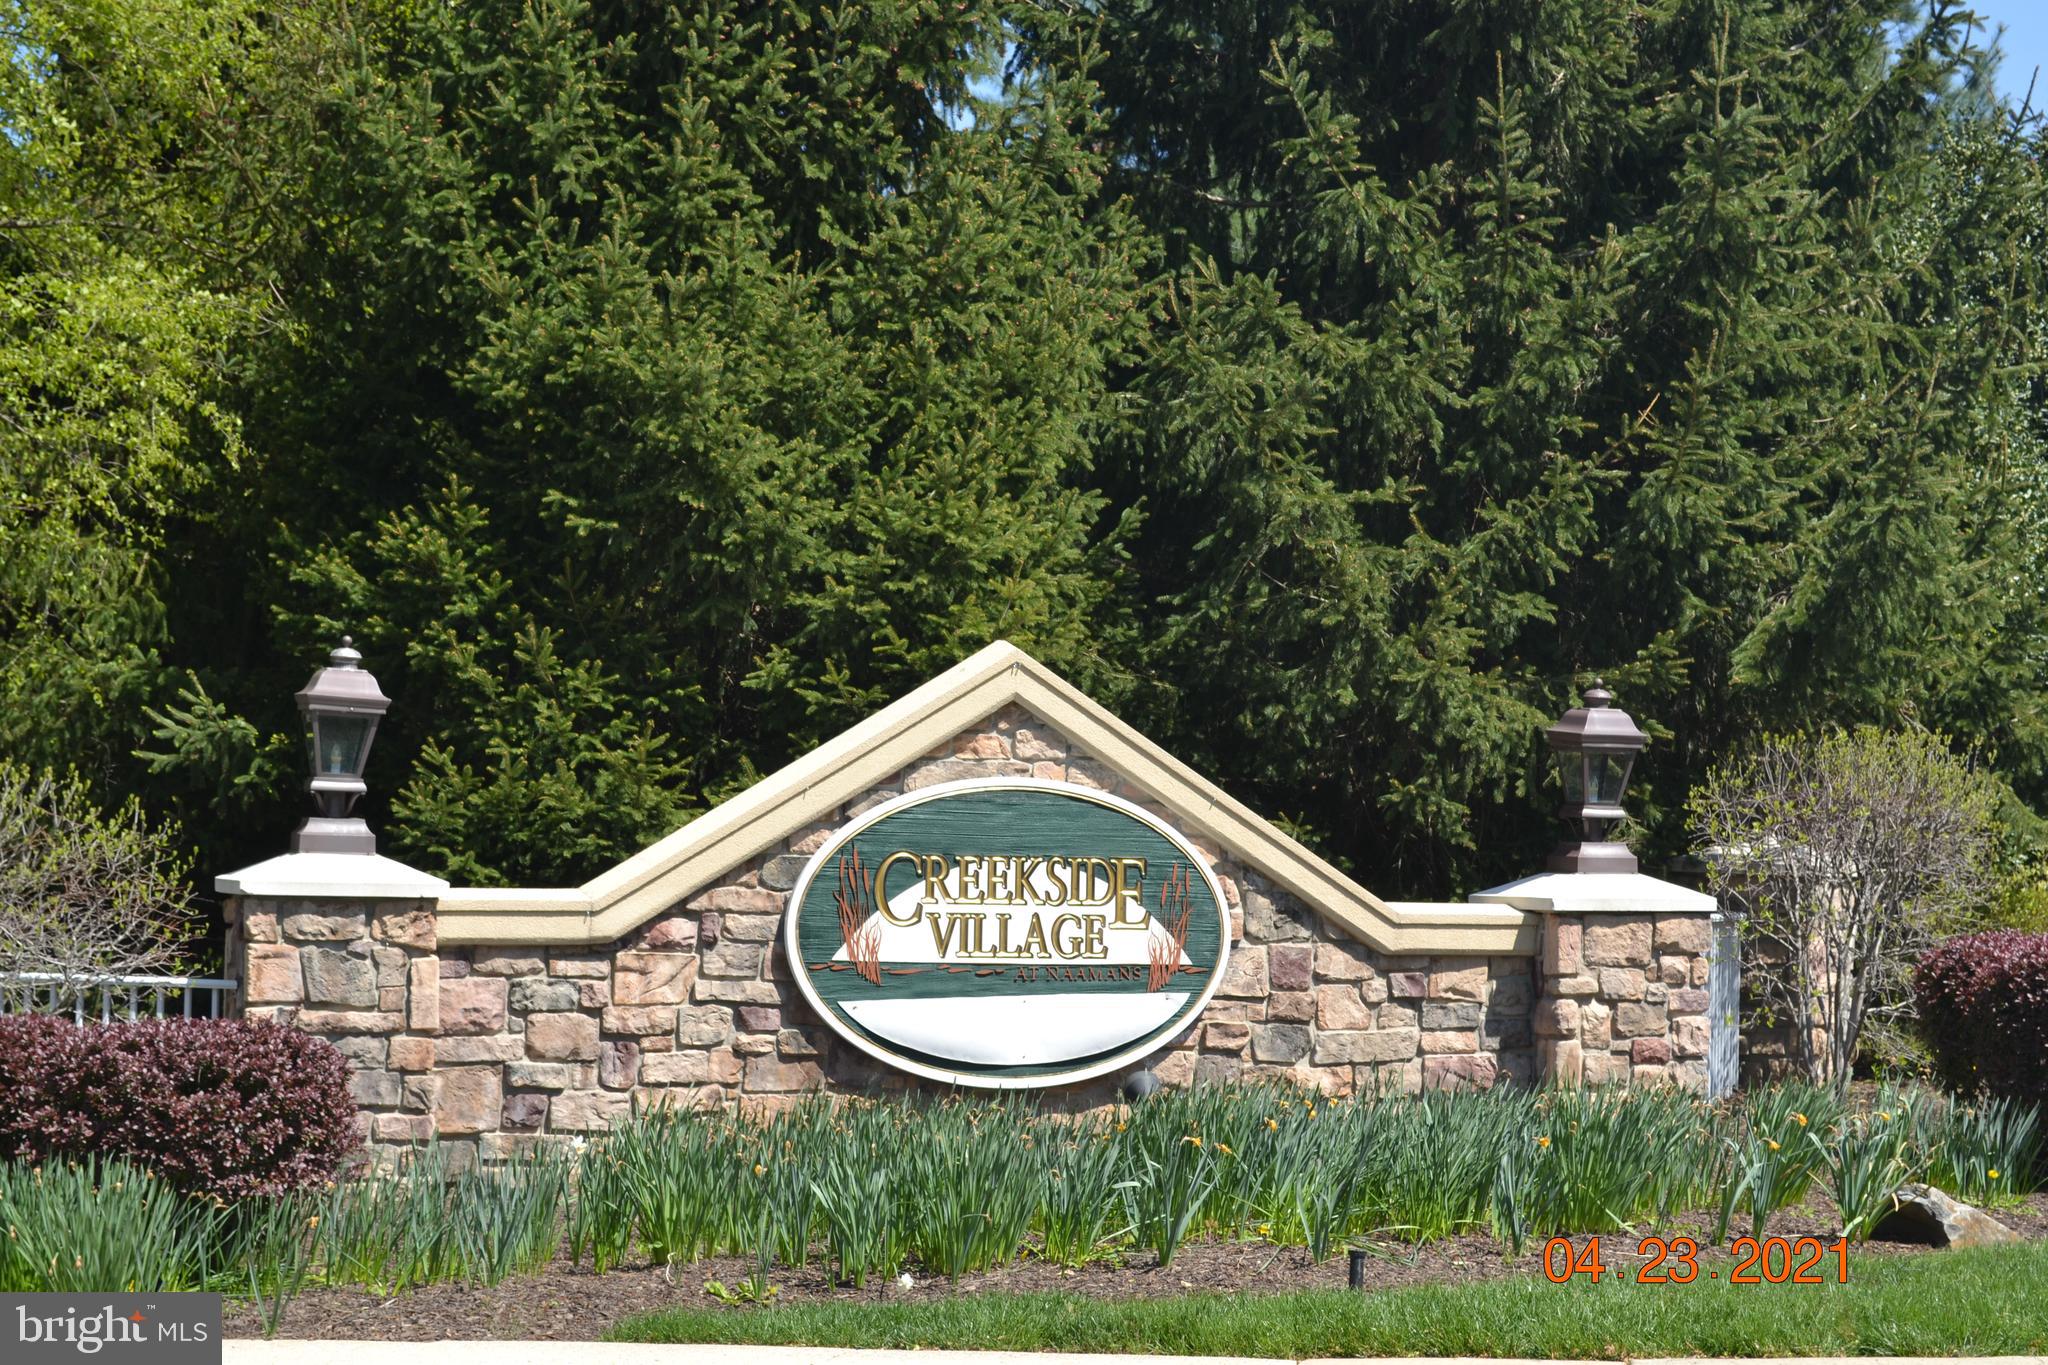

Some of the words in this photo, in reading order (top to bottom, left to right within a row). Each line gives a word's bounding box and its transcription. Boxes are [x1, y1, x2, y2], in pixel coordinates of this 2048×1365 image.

[873, 850, 1149, 929] CREEKSIDE
[925, 912, 1109, 959] VILLAGE
[1013, 967, 1038, 982] AT
[1046, 966, 1142, 982] NAAMANS
